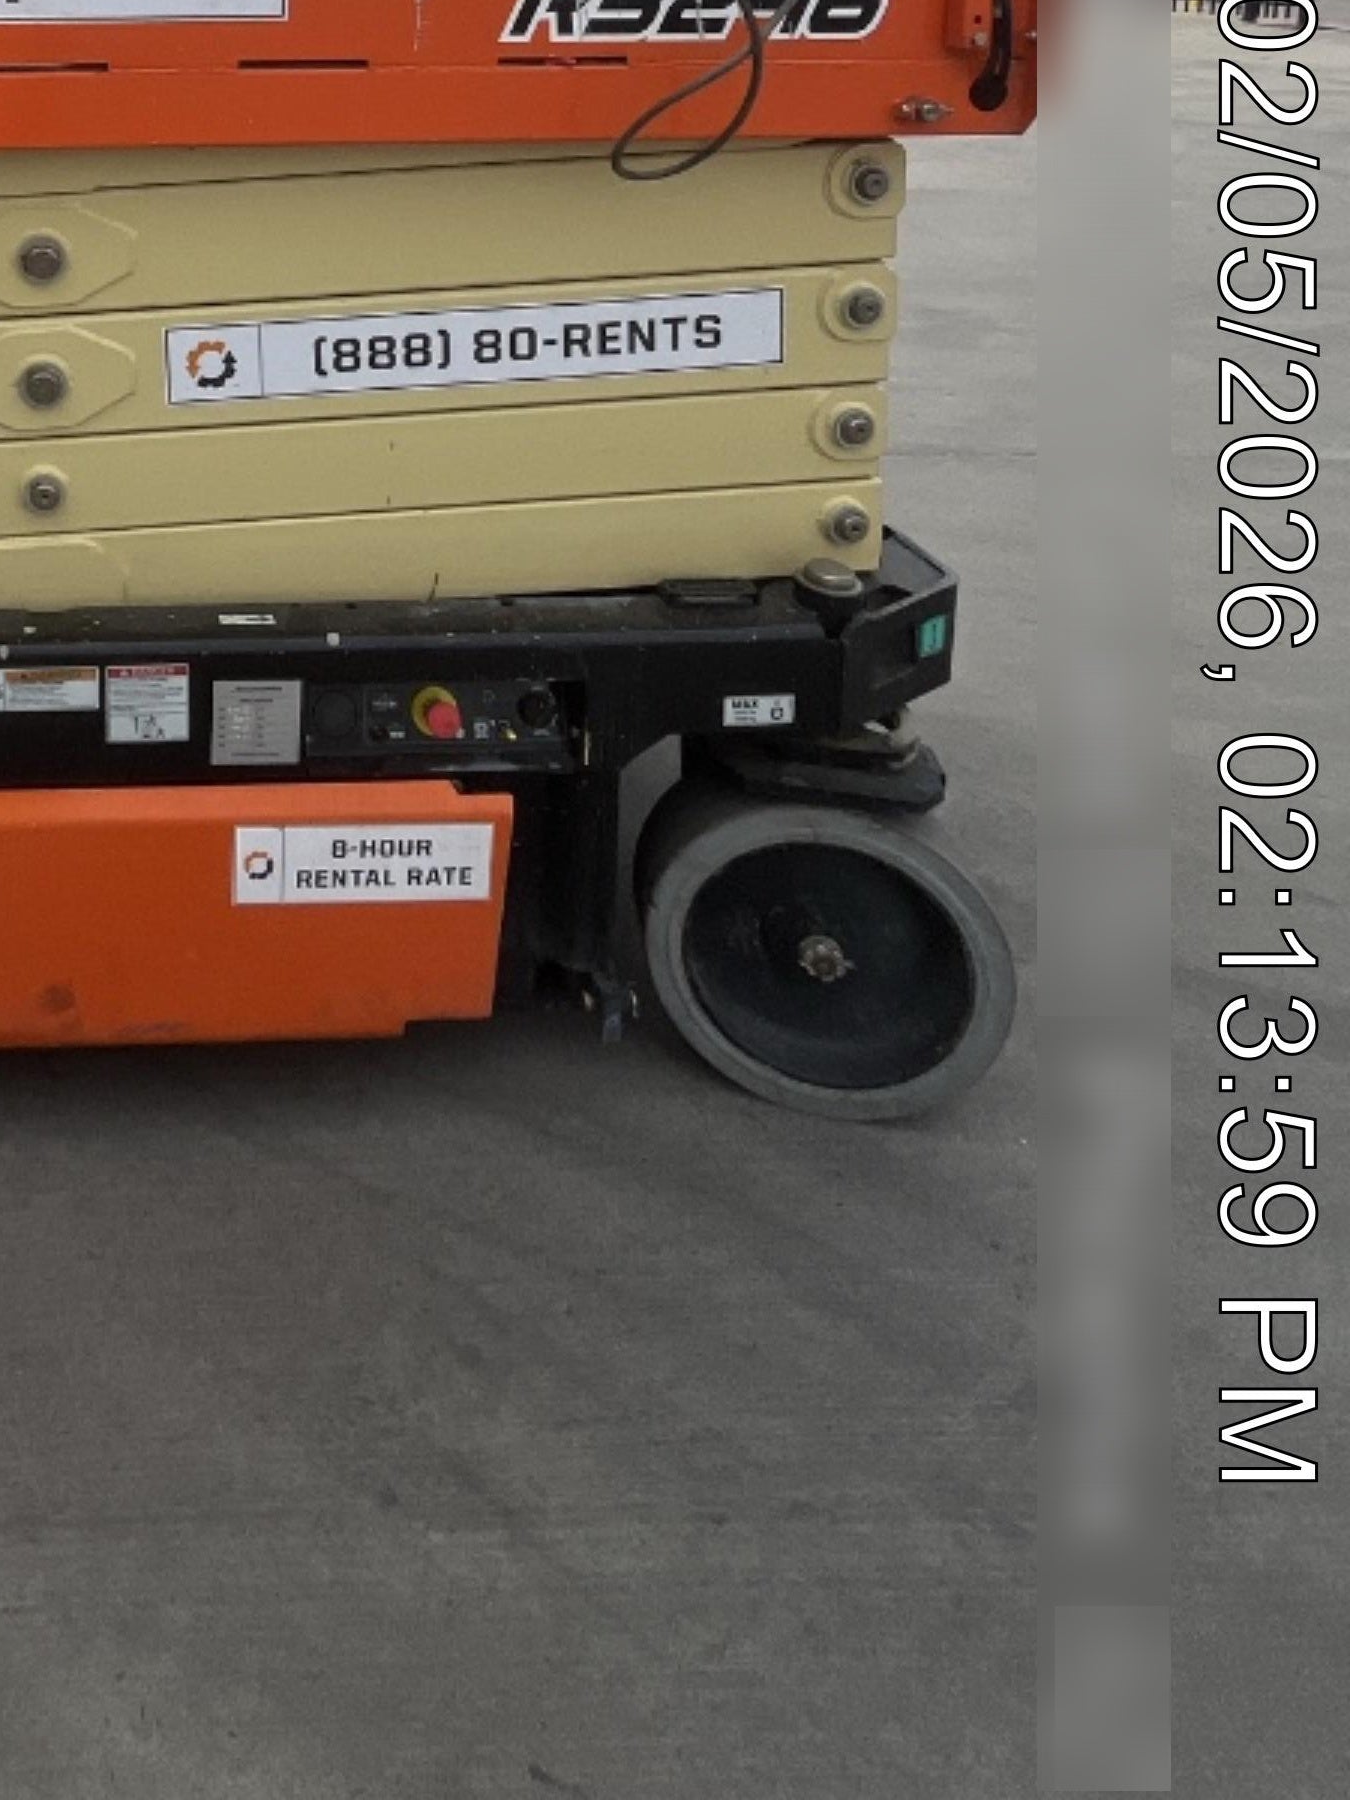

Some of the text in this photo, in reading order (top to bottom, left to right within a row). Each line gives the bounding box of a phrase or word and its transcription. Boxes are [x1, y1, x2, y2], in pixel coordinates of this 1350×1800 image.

[312, 314, 724, 377] (888) 80-RENTS
[331, 839, 433, 859] 8-HOUR
[295, 866, 473, 889] RENTAL RATE
